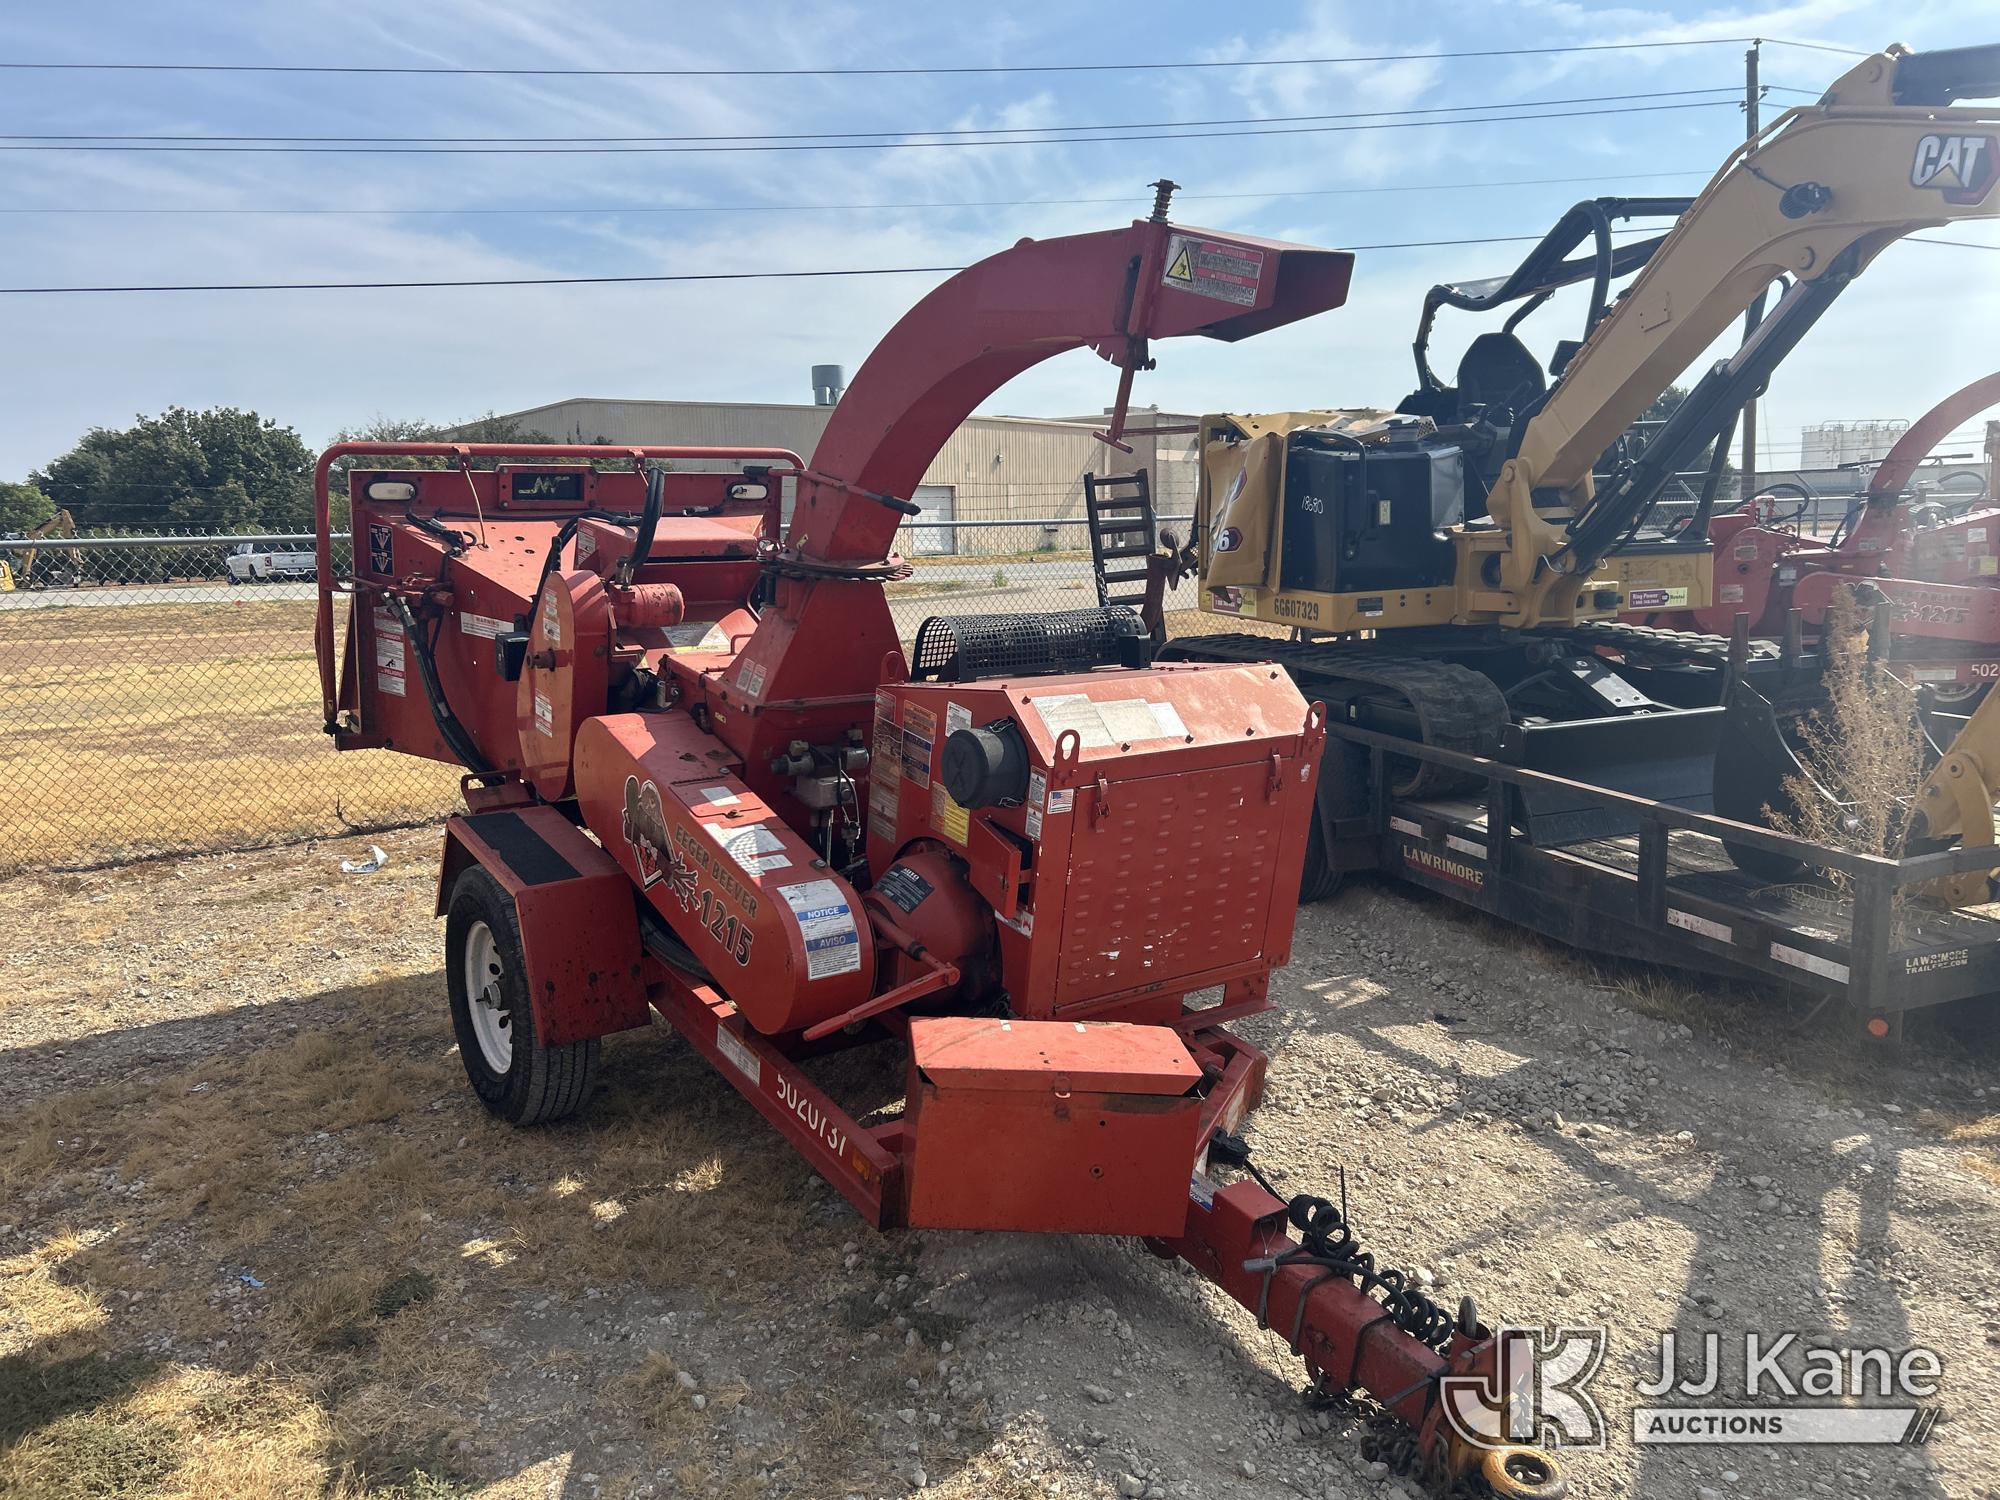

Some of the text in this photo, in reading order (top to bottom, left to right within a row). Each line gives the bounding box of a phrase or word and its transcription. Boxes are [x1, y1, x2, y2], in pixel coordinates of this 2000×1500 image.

[1912, 135, 1986, 188] CAT
[1273, 598, 1319, 622] 6G607329
[674, 822, 710, 872] EEGER
[711, 859, 758, 919] BEEVER
[1403, 844, 1484, 886] LAWRIMORE
[700, 888, 755, 967] 1215
[807, 906, 840, 919] NOTICE
[820, 935, 846, 948] AVISO
[1905, 948, 1969, 967] LAWRIMORE
